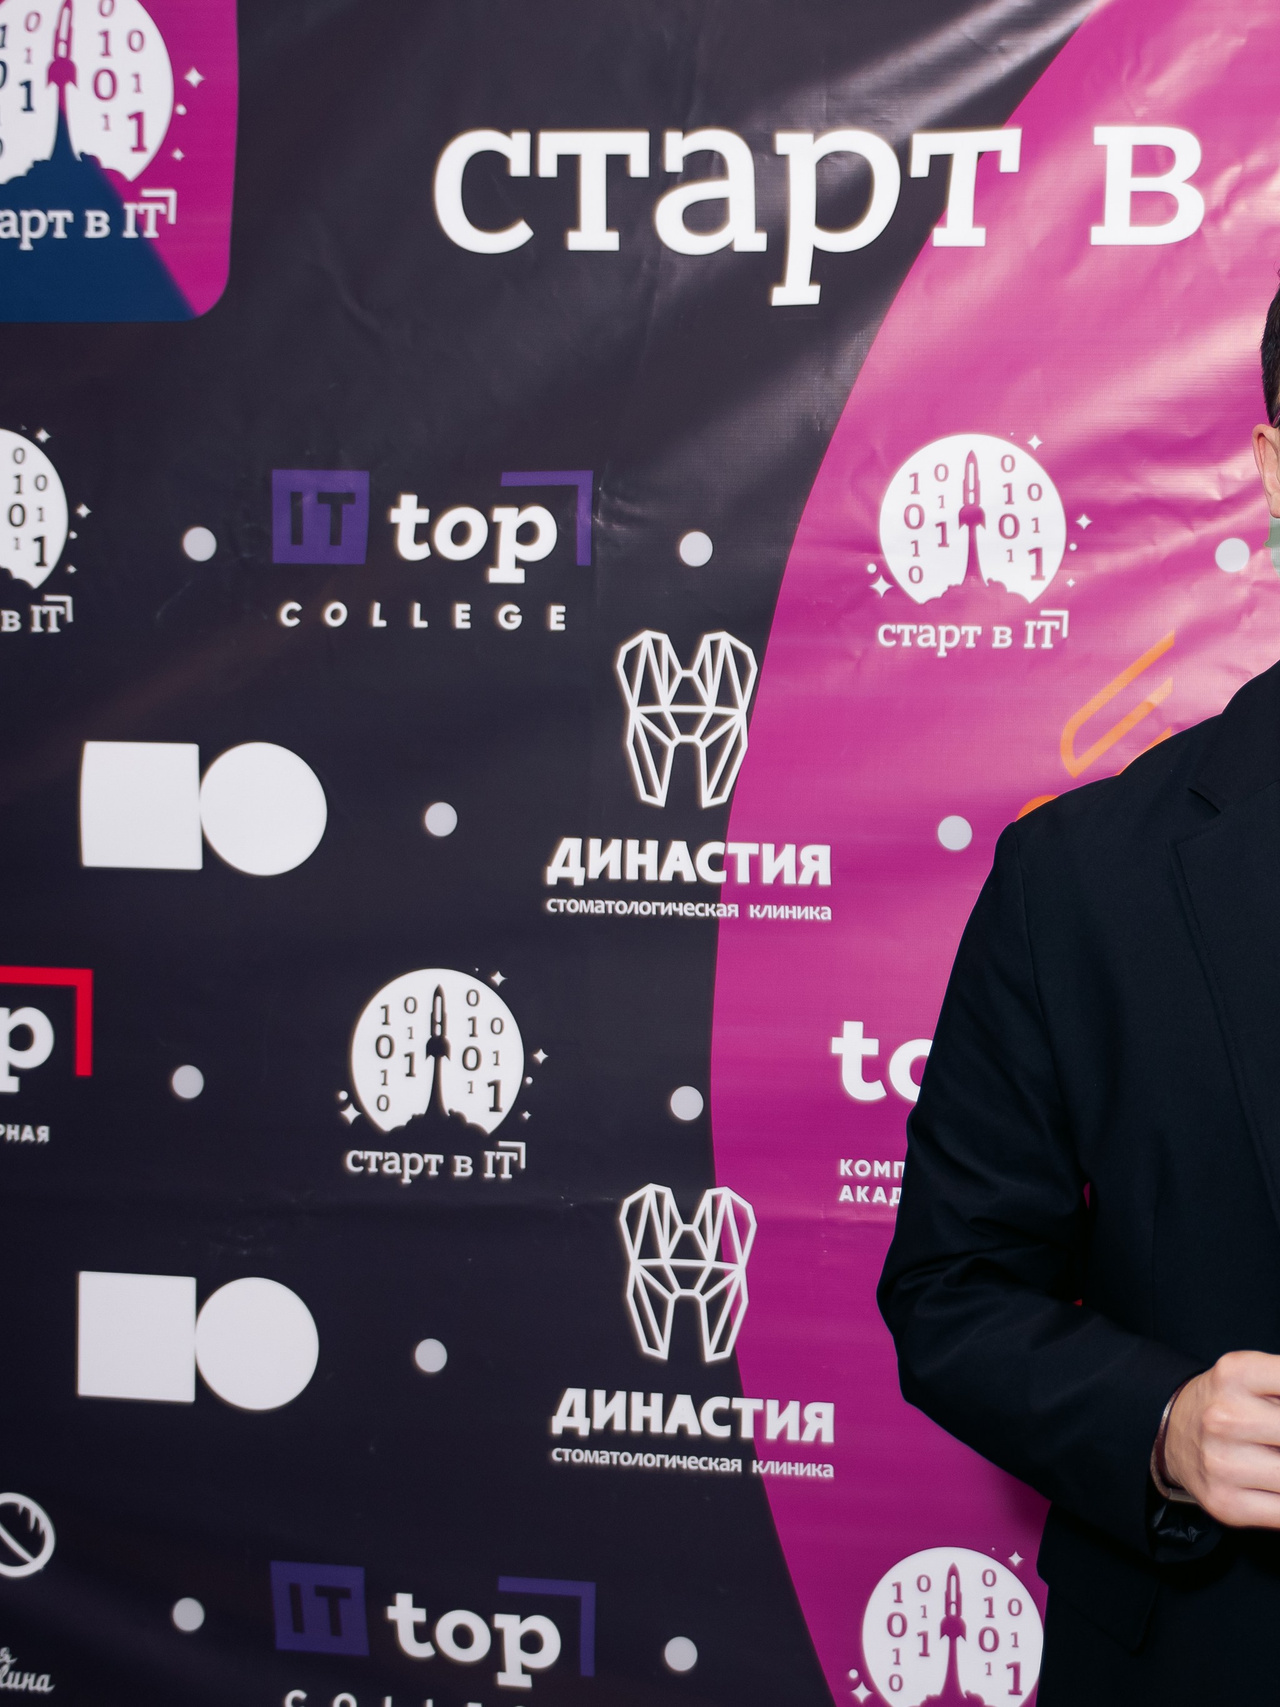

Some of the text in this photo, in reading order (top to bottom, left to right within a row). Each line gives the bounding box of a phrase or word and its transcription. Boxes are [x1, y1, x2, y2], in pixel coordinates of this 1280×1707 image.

[84, 210, 111, 239] в
[122, 202, 166, 239] IT
[434, 128, 1022, 306] старт
[1090, 125, 1206, 246] в
[289, 491, 357, 547] IT
[389, 494, 558, 584] top
[30, 604, 66, 633] IT
[279, 601, 566, 631] COLLEGE
[877, 620, 1060, 658] старт в IT
[545, 837, 832, 887] ДИНАСТИЯ
[546, 898, 832, 921] стоматологическая клиника
[345, 1149, 518, 1184] старт в IT
[551, 1387, 835, 1443] ДИНАСТИЯ
[551, 1447, 835, 1479] стоматологическая клиника
[288, 1581, 354, 1639] IT
[386, 1592, 562, 1688] top
